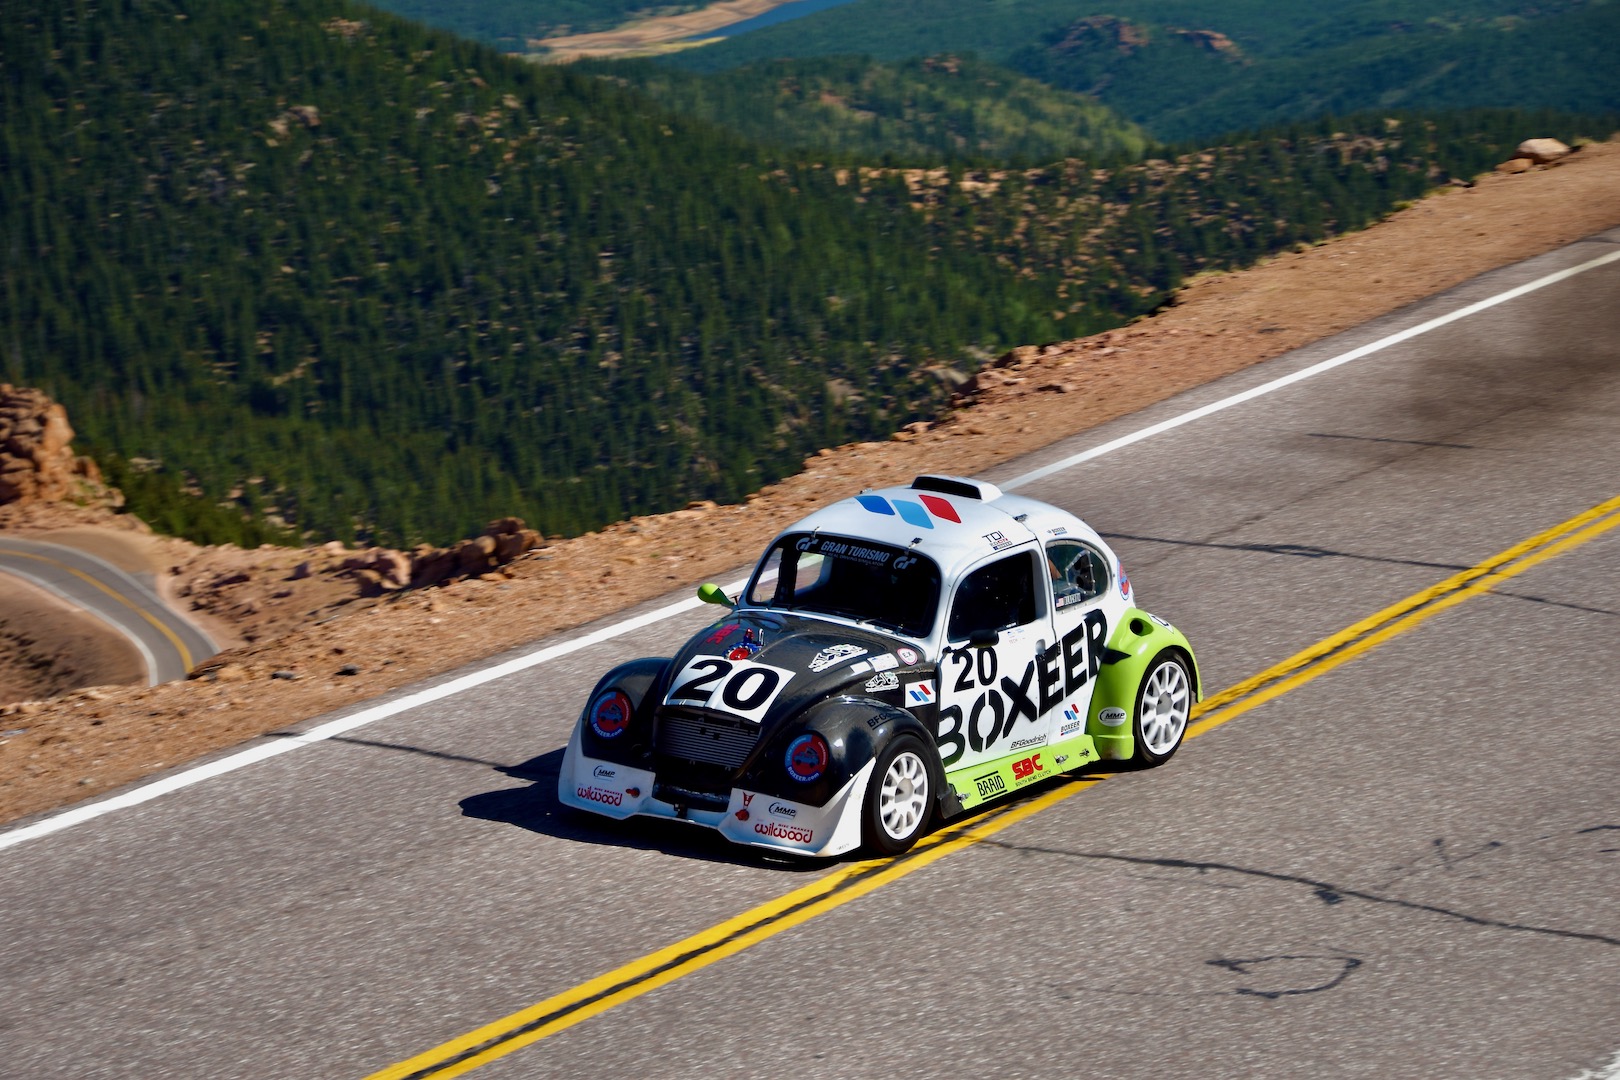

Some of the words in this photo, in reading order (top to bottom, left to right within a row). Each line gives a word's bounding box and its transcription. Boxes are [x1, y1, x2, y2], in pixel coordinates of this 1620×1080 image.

[982, 530, 1005, 542] TDI
[820, 540, 848, 554] GRAN
[848, 546, 890, 563] TURISMO
[952, 646, 998, 693] 20
[670, 659, 780, 711] 20
[938, 608, 1107, 768] BOXEER
[1060, 721, 1080, 733] BOXEER
[1010, 733, 1047, 749] BFGoodrich
[1012, 753, 1043, 780] SBC
[577, 786, 623, 806] wilwood
[976, 775, 1005, 797] BRAID
[774, 806, 796, 816] MMP
[755, 823, 813, 844] wilwood
